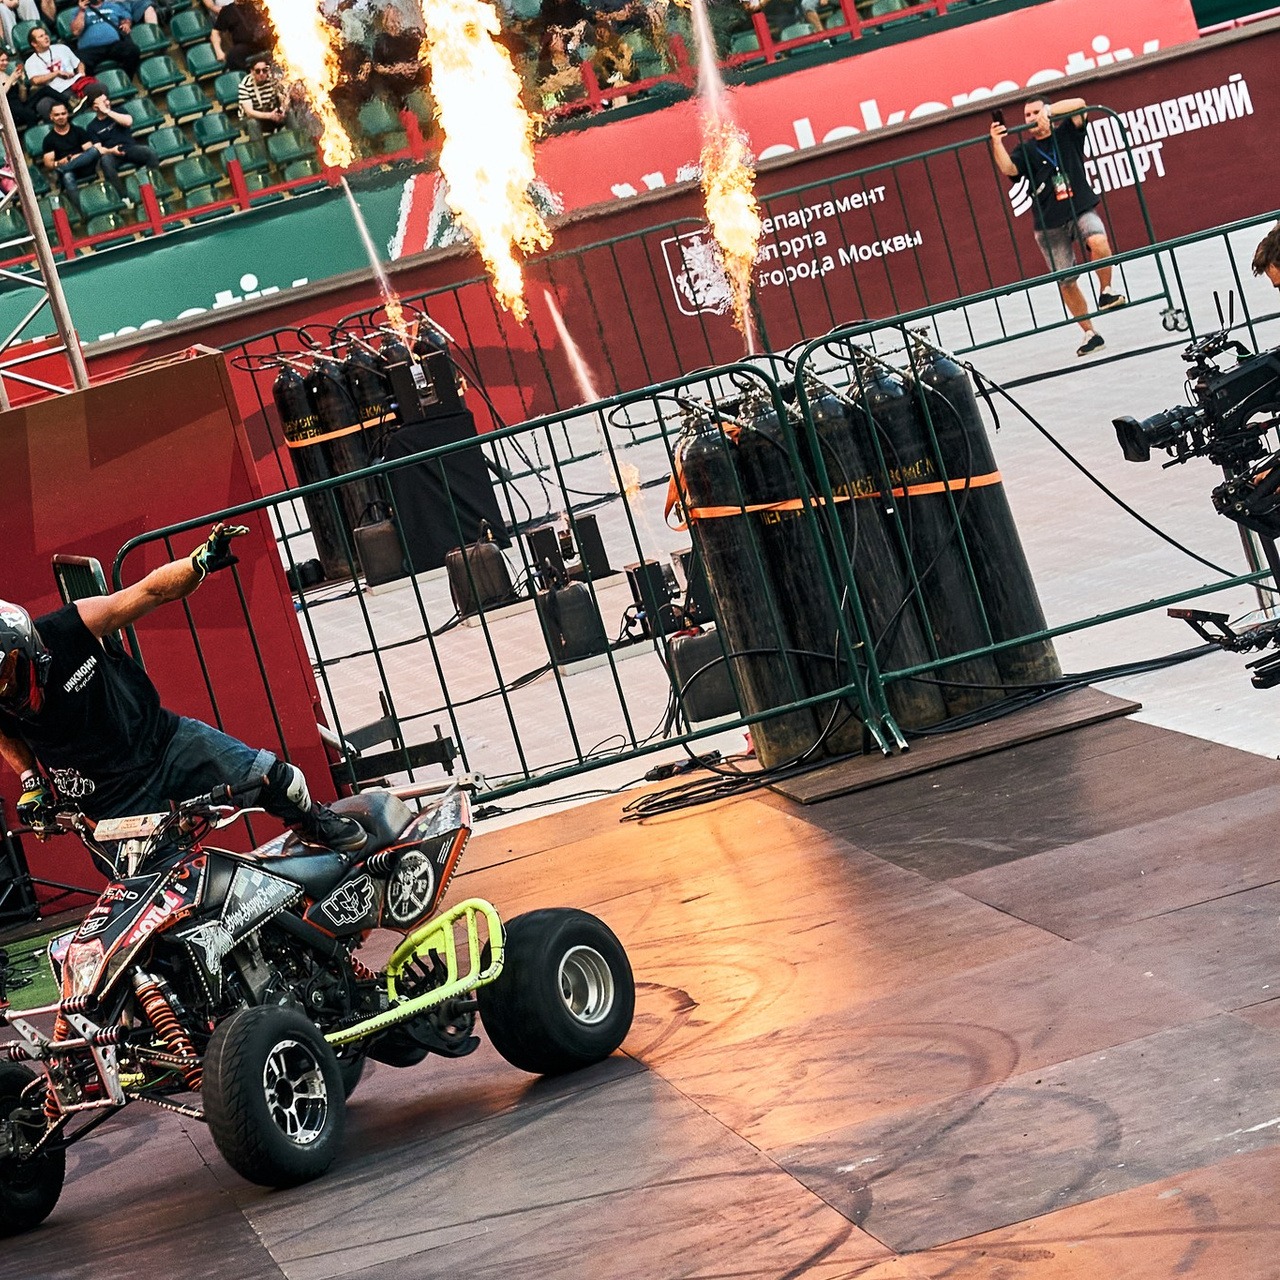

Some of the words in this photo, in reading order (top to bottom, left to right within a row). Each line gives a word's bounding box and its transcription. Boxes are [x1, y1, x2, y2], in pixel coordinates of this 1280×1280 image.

[1084, 141, 1166, 195] СПОРТ
[761, 185, 886, 234] епартамент
[758, 230, 828, 264] порта
[837, 230, 924, 267] Москвы
[63, 655, 98, 693] UNKNOWN
